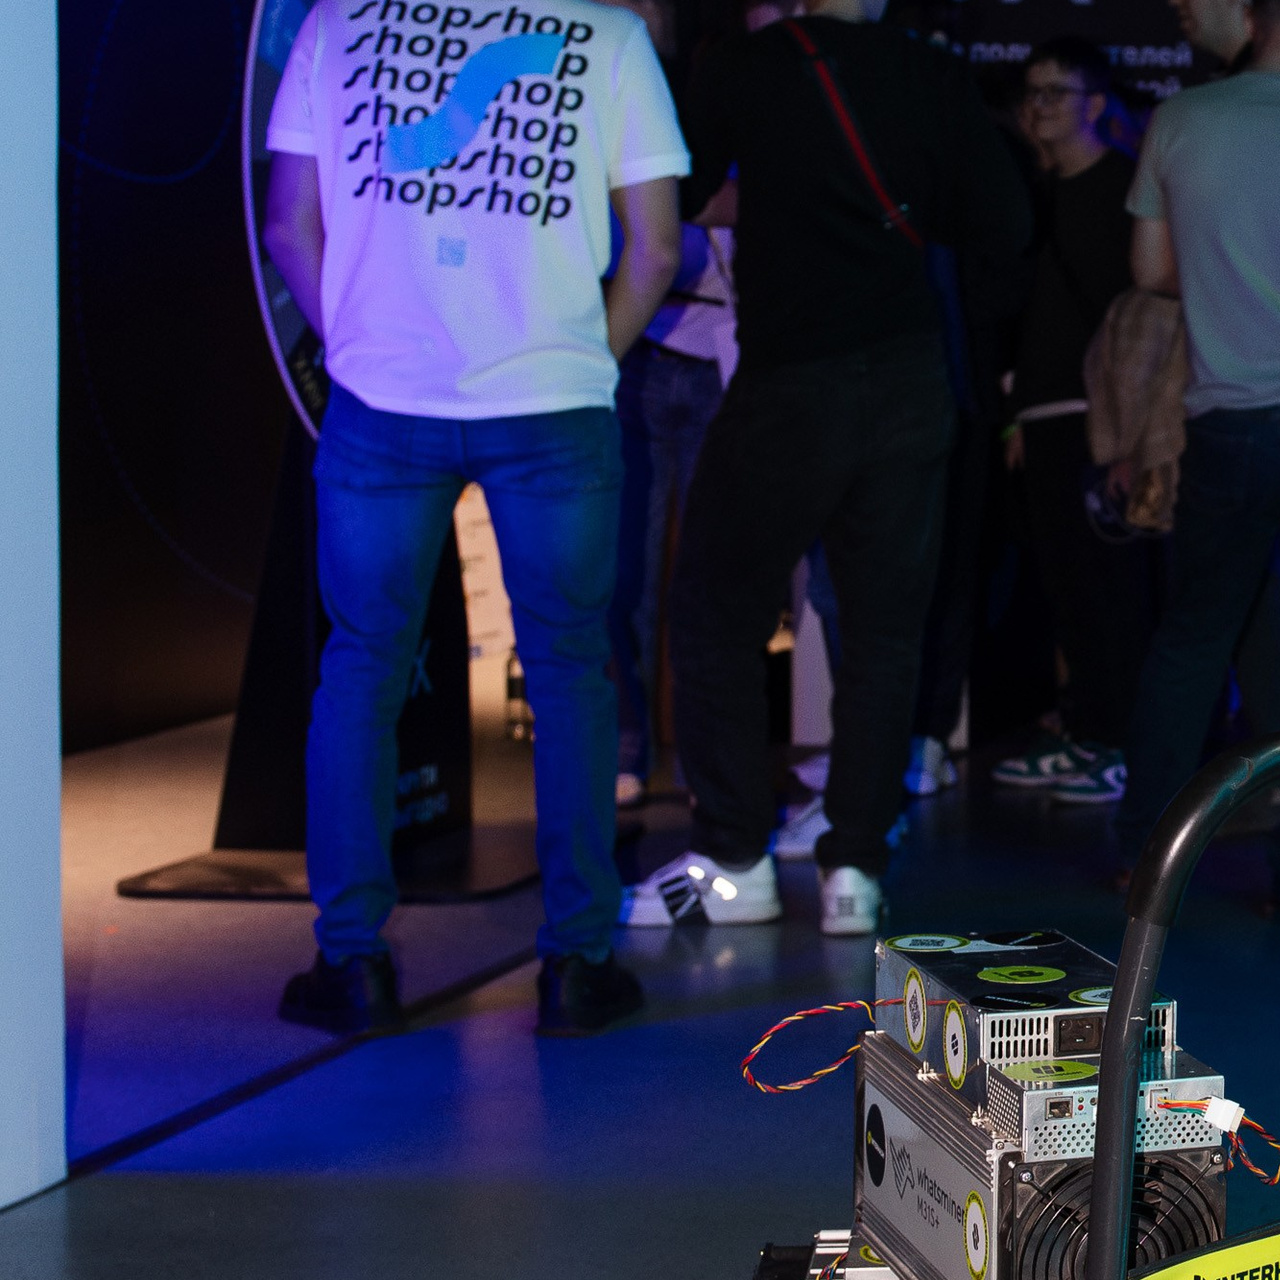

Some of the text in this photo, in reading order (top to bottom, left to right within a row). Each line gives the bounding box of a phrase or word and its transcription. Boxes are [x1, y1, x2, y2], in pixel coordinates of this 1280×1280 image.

[353, 169, 572, 226] shopshop
[916, 1167, 966, 1227] whatsminer
[916, 1195, 940, 1230] M31S+
